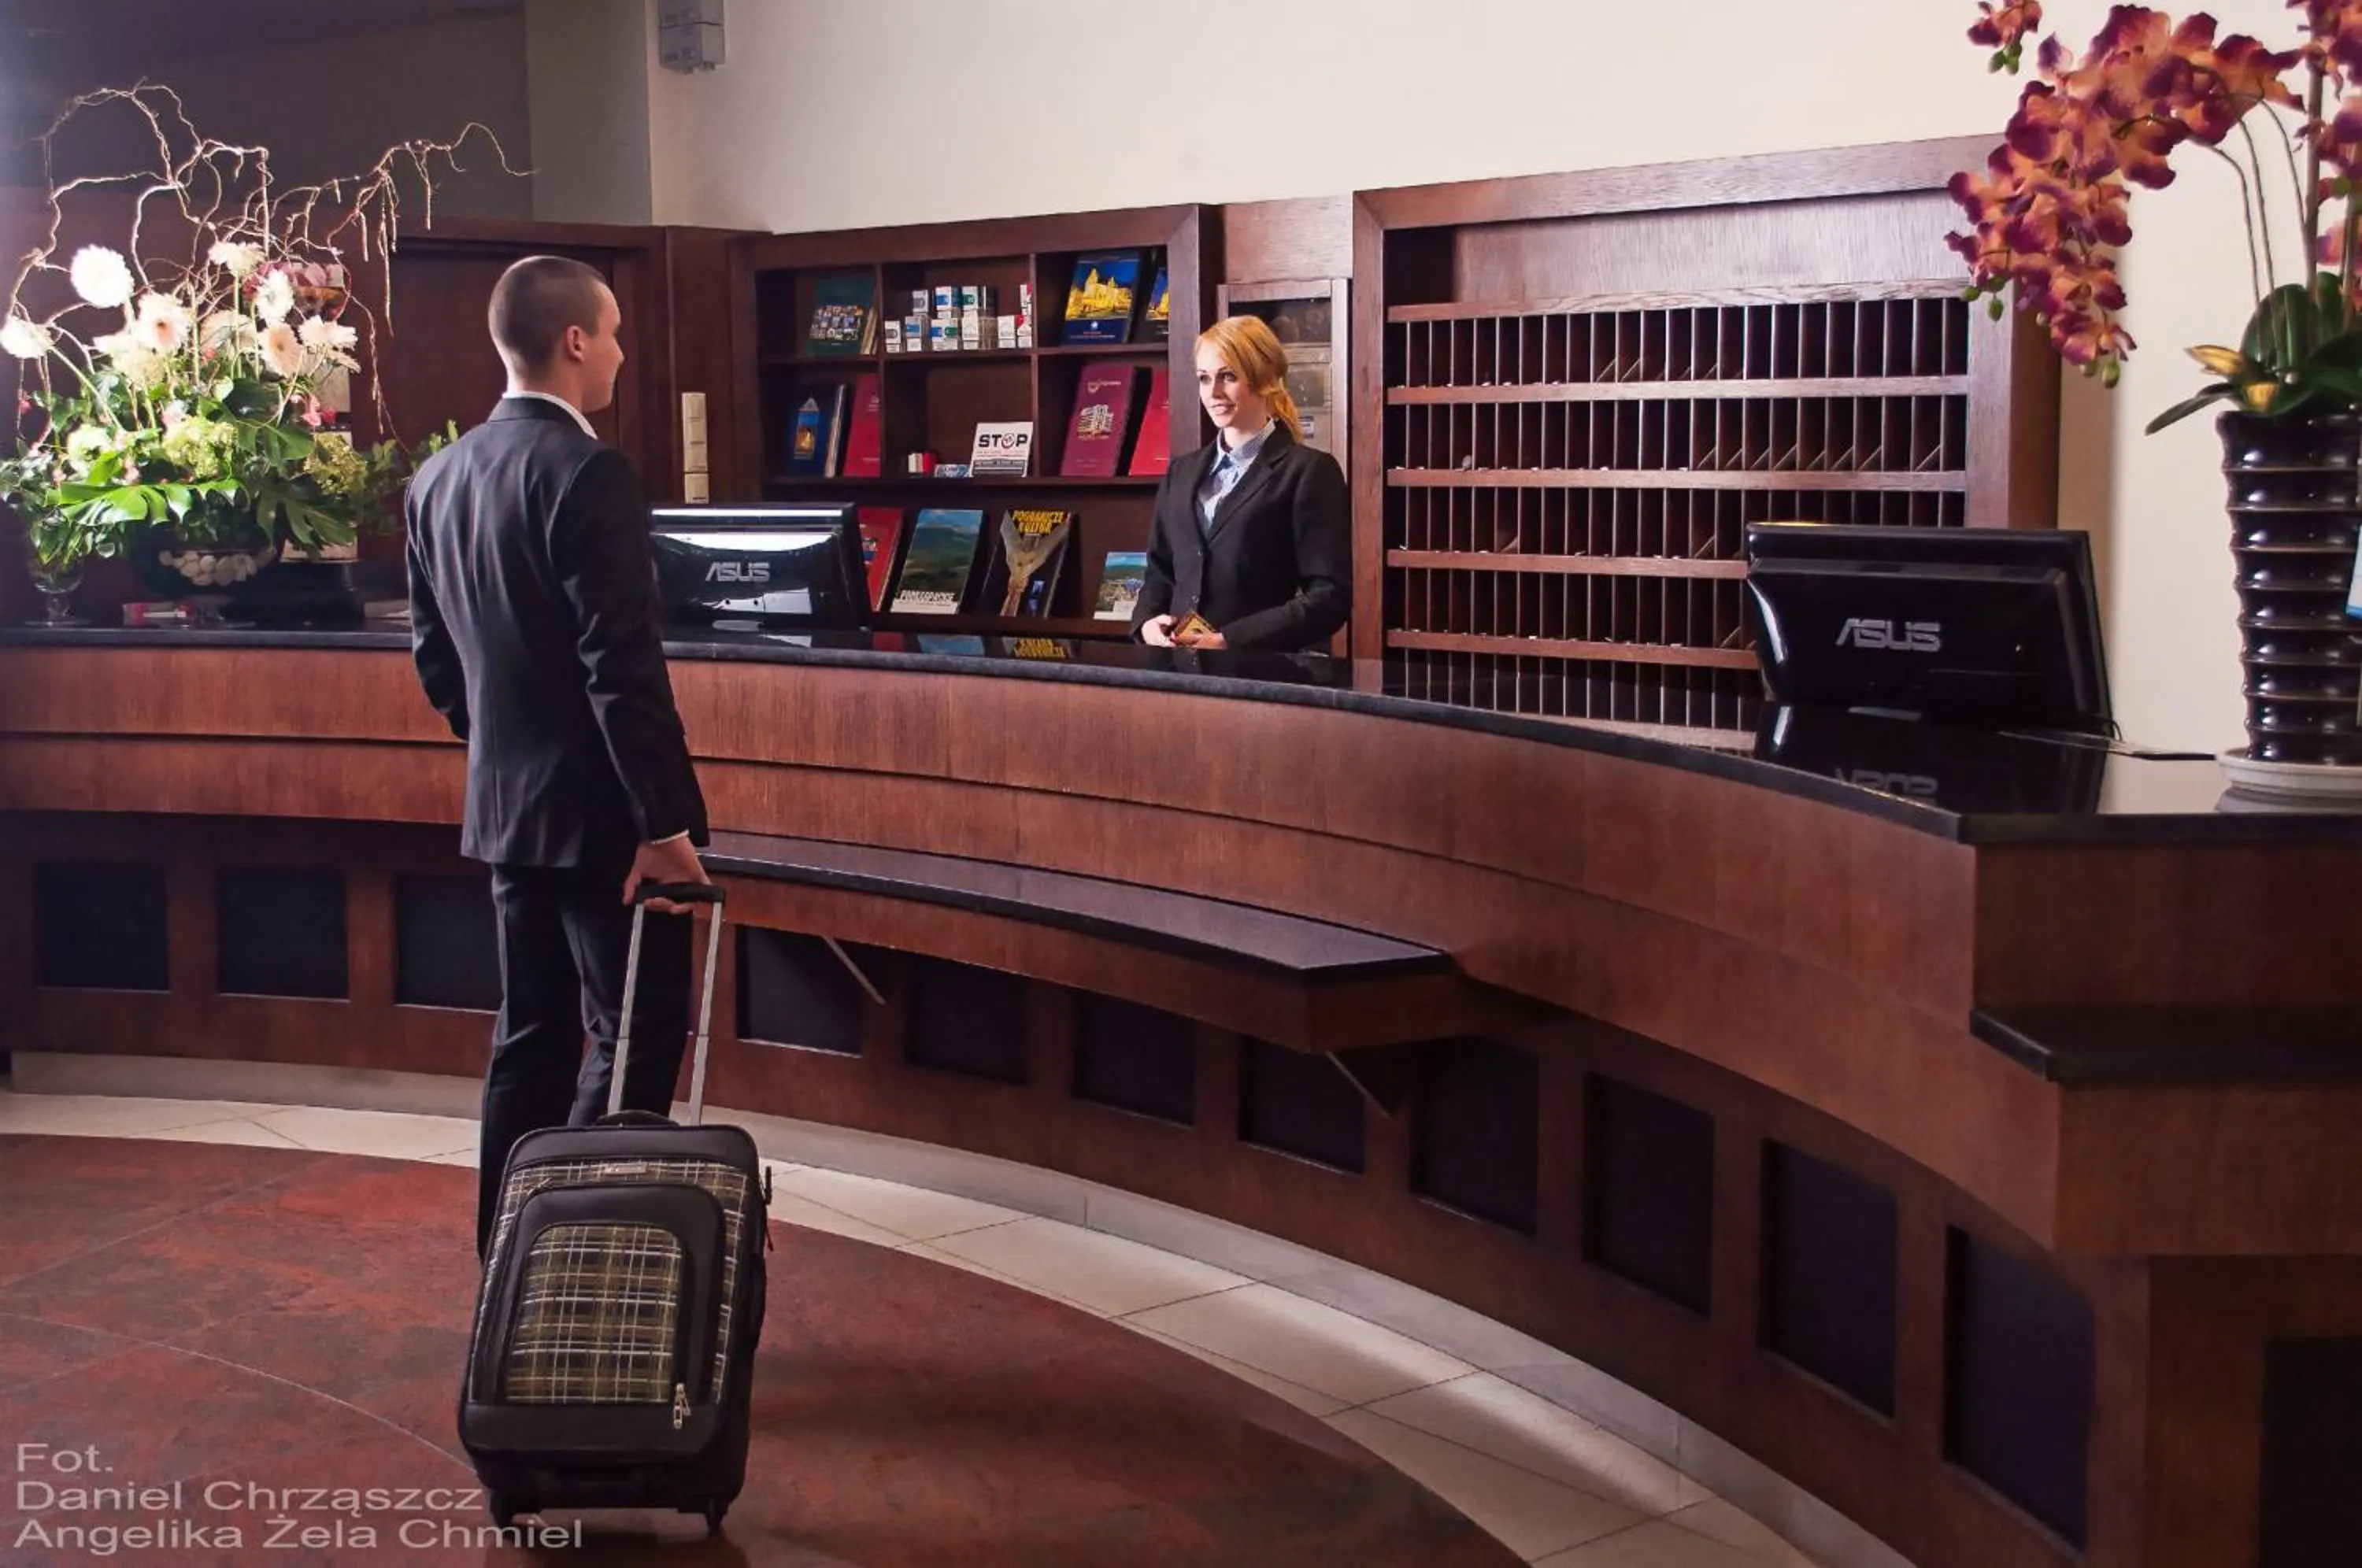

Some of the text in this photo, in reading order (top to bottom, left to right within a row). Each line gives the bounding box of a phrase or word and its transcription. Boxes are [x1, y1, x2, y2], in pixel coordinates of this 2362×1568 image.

[978, 433, 1028, 449] STOP
[705, 561, 771, 582] ASUS
[1835, 618, 1941, 653] ASUS
